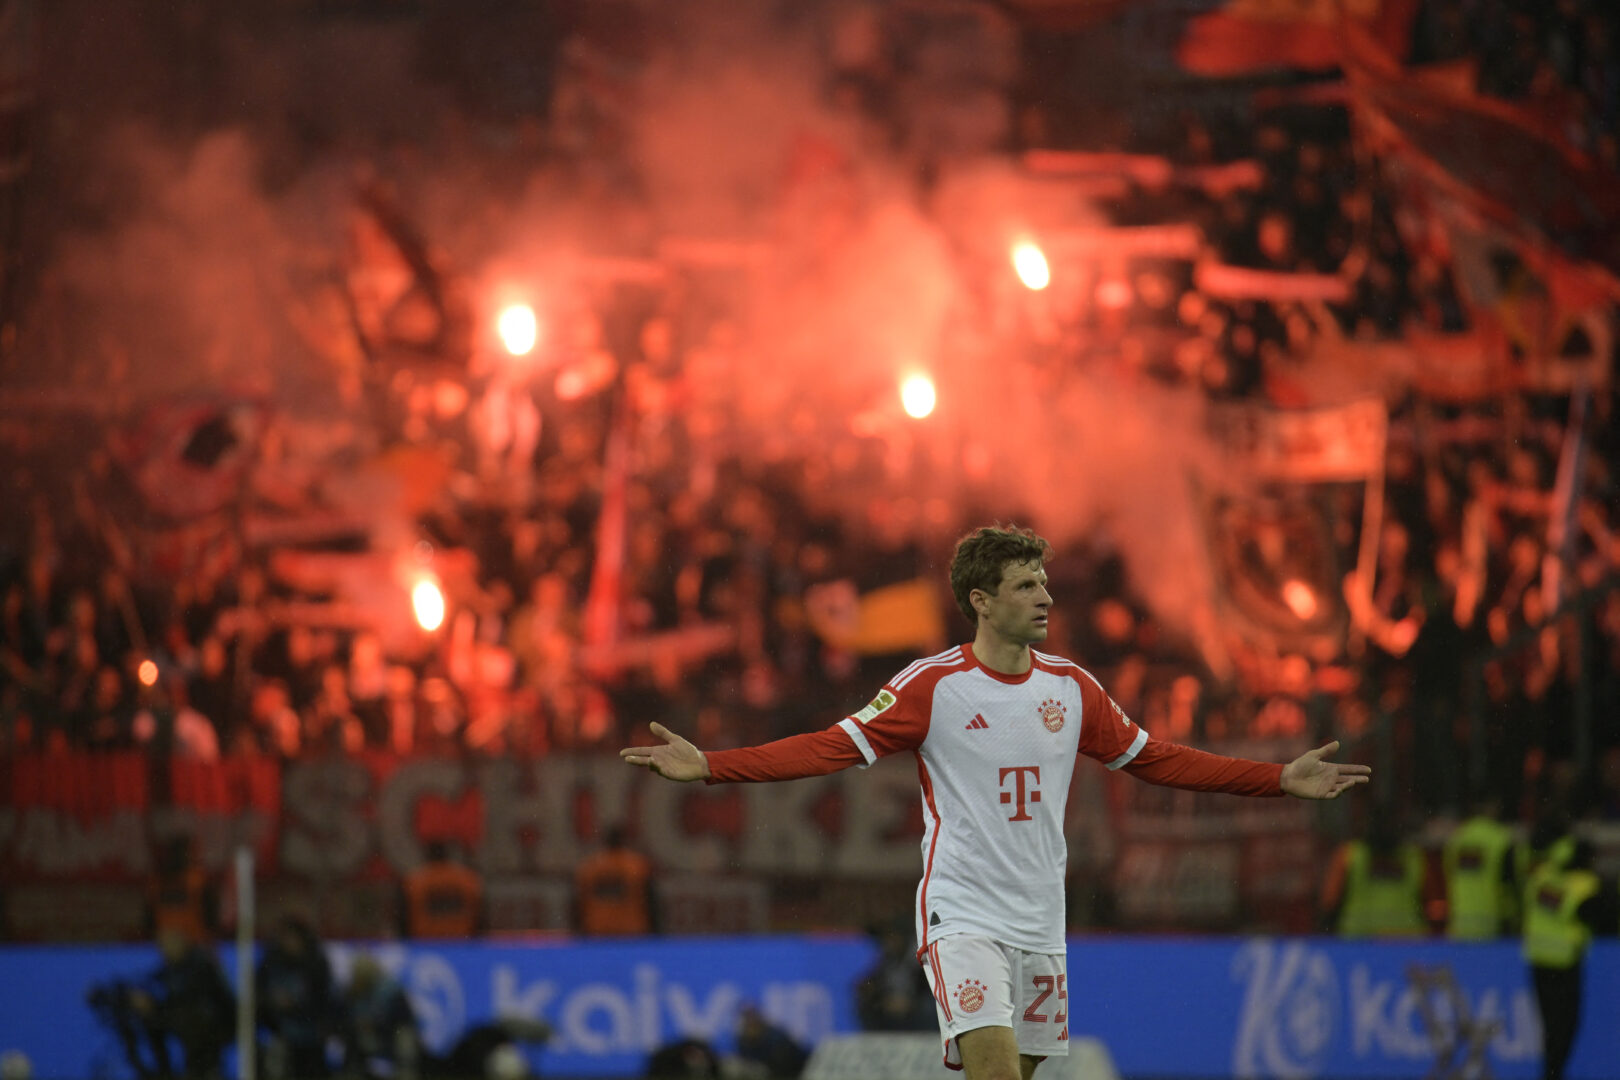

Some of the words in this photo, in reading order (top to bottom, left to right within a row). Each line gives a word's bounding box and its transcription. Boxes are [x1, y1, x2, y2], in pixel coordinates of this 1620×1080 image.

[999, 766, 1041, 822] T
[488, 962, 834, 1056] kaiyn
[1023, 974, 1067, 1023] 25
